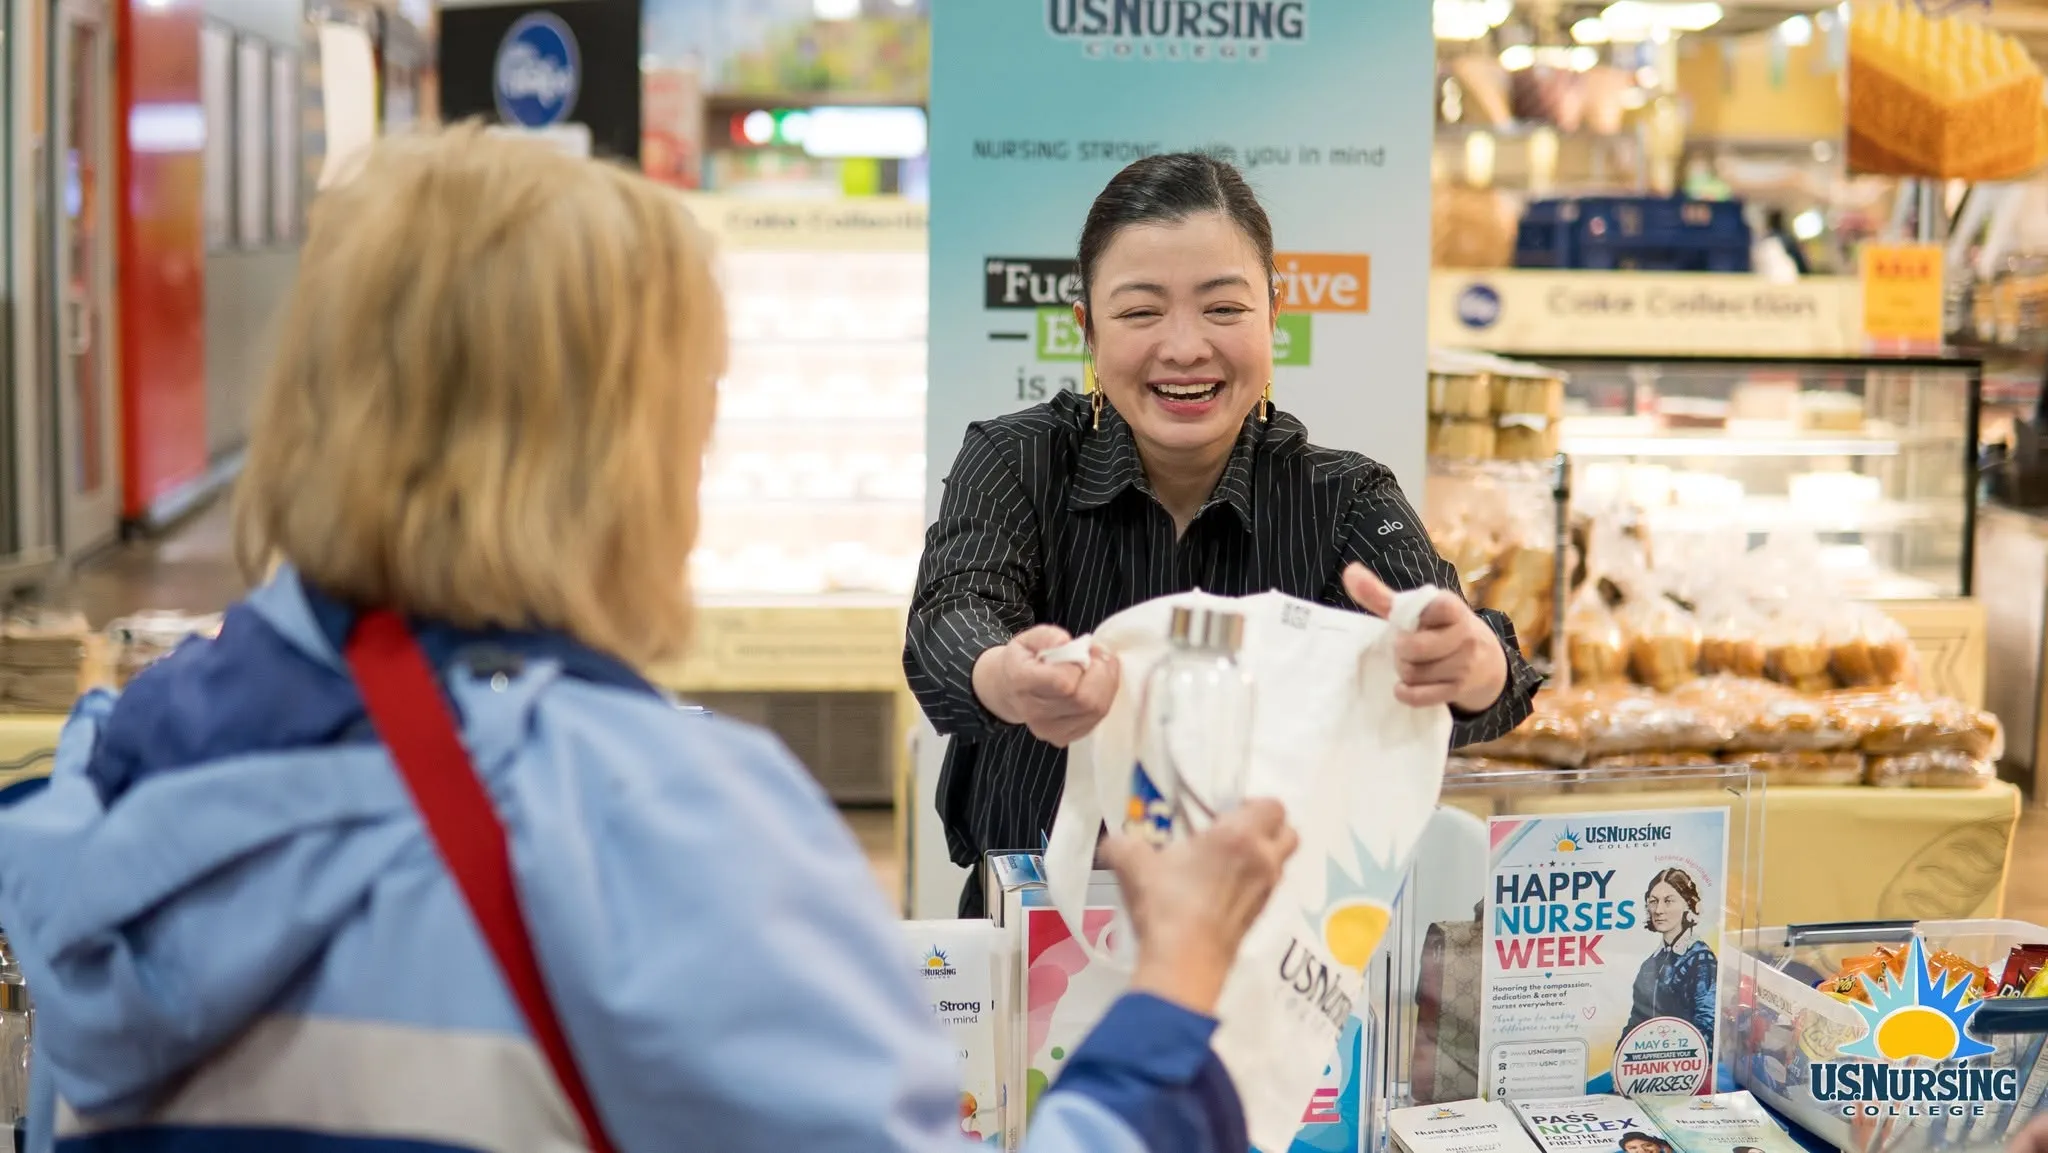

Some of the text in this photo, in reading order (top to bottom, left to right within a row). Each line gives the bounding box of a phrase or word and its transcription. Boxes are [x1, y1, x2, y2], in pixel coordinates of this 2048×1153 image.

[1086, 43, 1264, 59] COLLEGE
[973, 138, 1070, 162] NURSING
[1246, 148, 1290, 168] you
[1300, 145, 1320, 165] in
[1330, 145, 1387, 168] mind
[1645, 284, 1818, 318] Collection
[1017, 366, 1046, 401] is
[1377, 519, 1404, 536] alo
[1598, 842, 1658, 850] COLLEGE
[1496, 869, 1616, 905] HAPPY
[1494, 900, 1636, 937] NURSES
[1494, 934, 1605, 970] WEEK
[1492, 984, 1528, 993] Honoring
[1530, 983, 1541, 991] the
[1492, 993, 1532, 1001] dedication
[939, 1000, 981, 1013] Strong
[1518, 1001, 1566, 1010] everywhere.
[953, 1015, 978, 1025] mind
[1634, 1040, 1661, 1050] MAY
[1662, 1039, 1670, 1049] 6
[1678, 1038, 1689, 1048] 12
[1631, 1053, 1641, 1061] WE
[1641, 1051, 1676, 1060] APPRECIATE
[1539, 1060, 1558, 1068] USNC
[1622, 1059, 1702, 1076] THANK YOU
[1627, 1074, 1699, 1095] NURSES!
[1531, 1112, 1599, 1125] PASS
[1676, 1118, 1721, 1126] Nursing
[1414, 1127, 1459, 1136] Nursing
[1460, 1123, 1498, 1132] Strong
[1537, 1117, 1640, 1136] NCLEX
